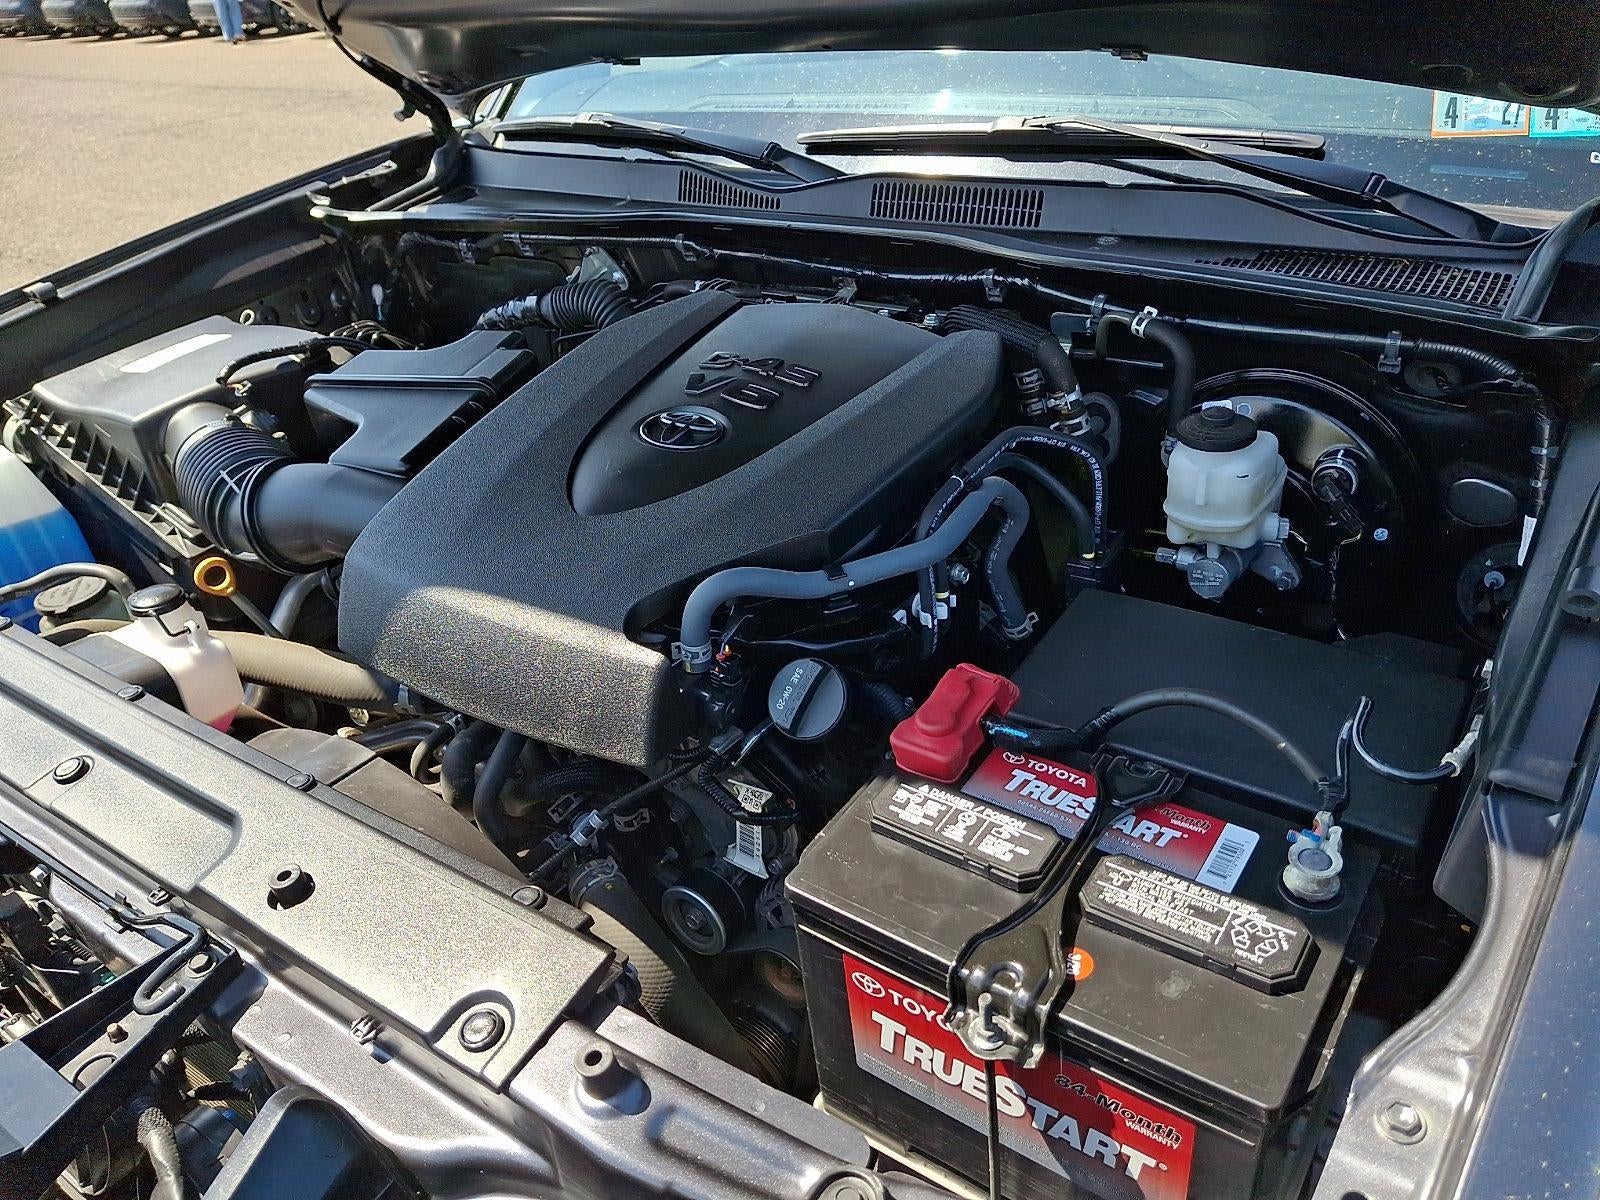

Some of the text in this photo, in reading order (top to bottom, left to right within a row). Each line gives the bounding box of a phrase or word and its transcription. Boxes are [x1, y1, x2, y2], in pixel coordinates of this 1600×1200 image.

[1444, 96, 1459, 129] 4
[1544, 107, 1560, 131] 4
[684, 372, 784, 410] V6
[790, 667, 804, 684] SAE
[776, 685, 793, 710] 0W-20
[1027, 758, 1087, 788] TOYOTA
[930, 787, 975, 812] DANGER
[982, 806, 1027, 830] POISON
[1170, 818, 1208, 835] WARRANTY
[887, 988, 955, 1032] TOYO
[1054, 1073, 1184, 1146] 84-Month
[1125, 1119, 1180, 1151] WARRANTY
